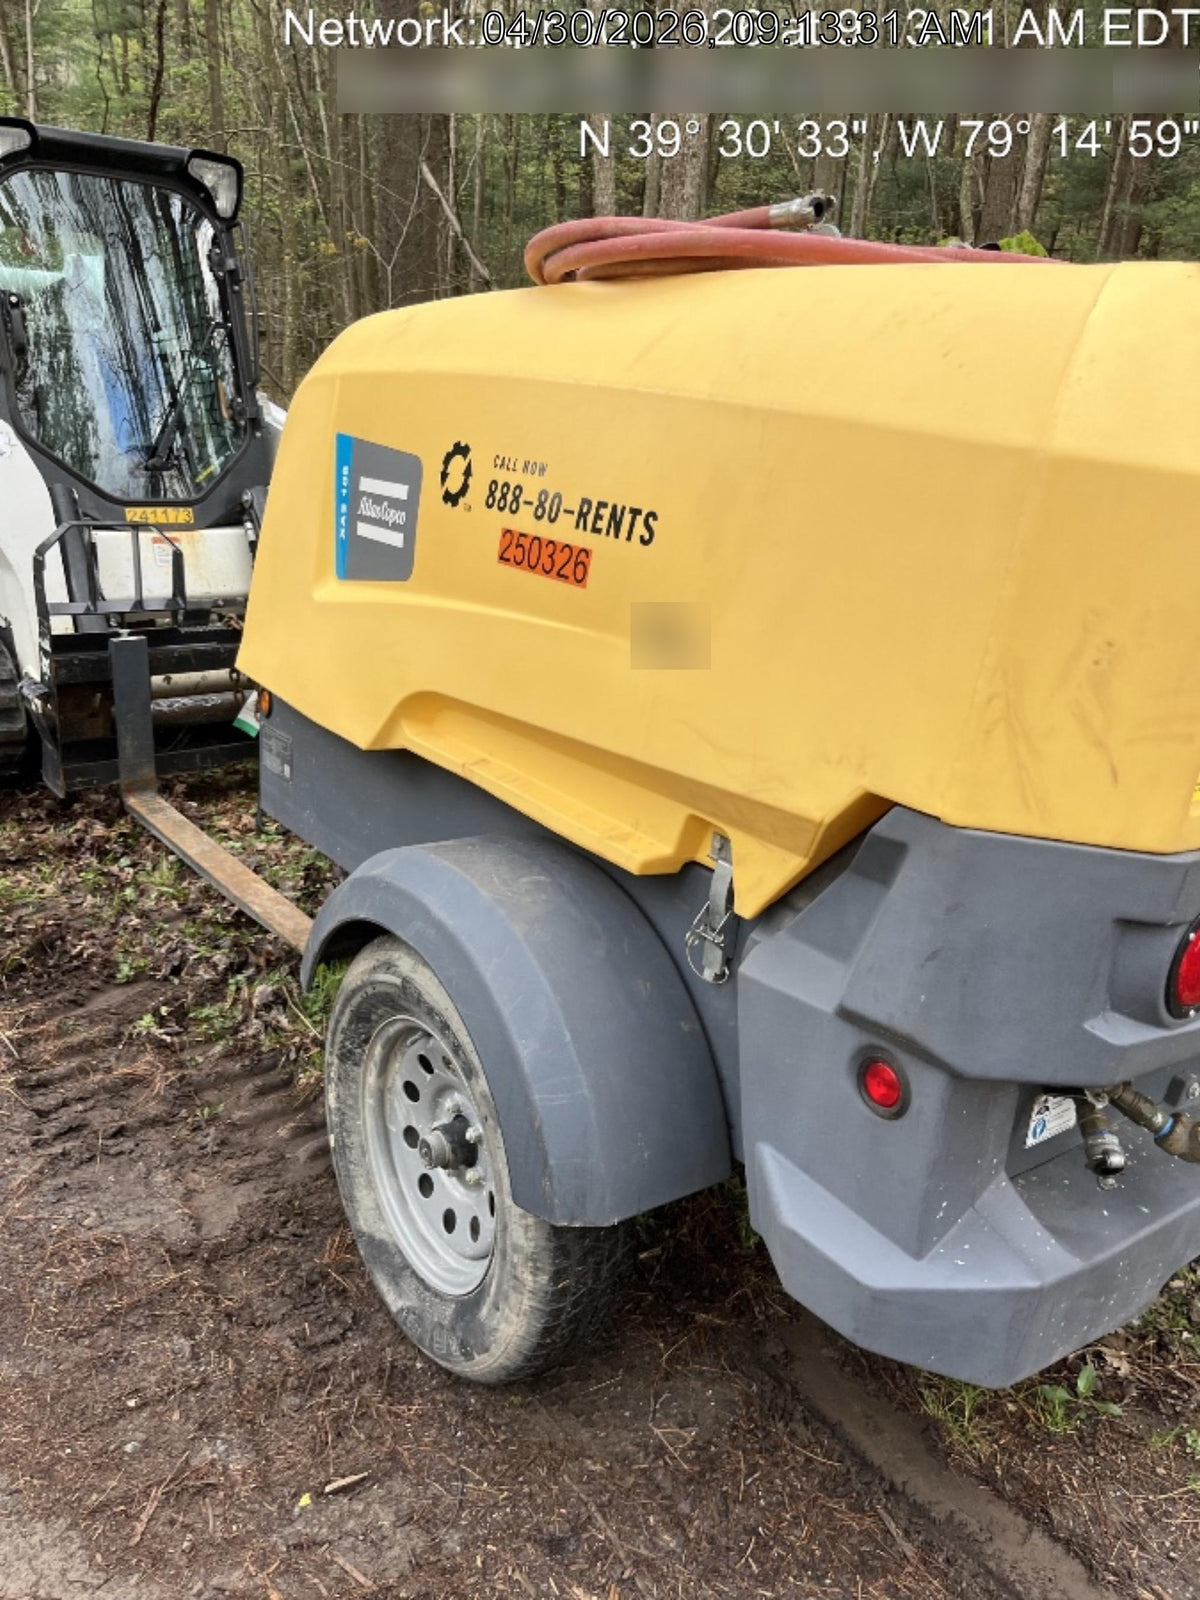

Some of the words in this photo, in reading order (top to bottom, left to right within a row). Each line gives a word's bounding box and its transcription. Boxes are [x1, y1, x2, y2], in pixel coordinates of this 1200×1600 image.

[493, 454, 518, 473] CALL
[522, 460, 548, 477] NOW
[126, 508, 193, 525] 241173
[485, 479, 659, 547] 888-80-RENTS
[498, 529, 590, 585] 250326
